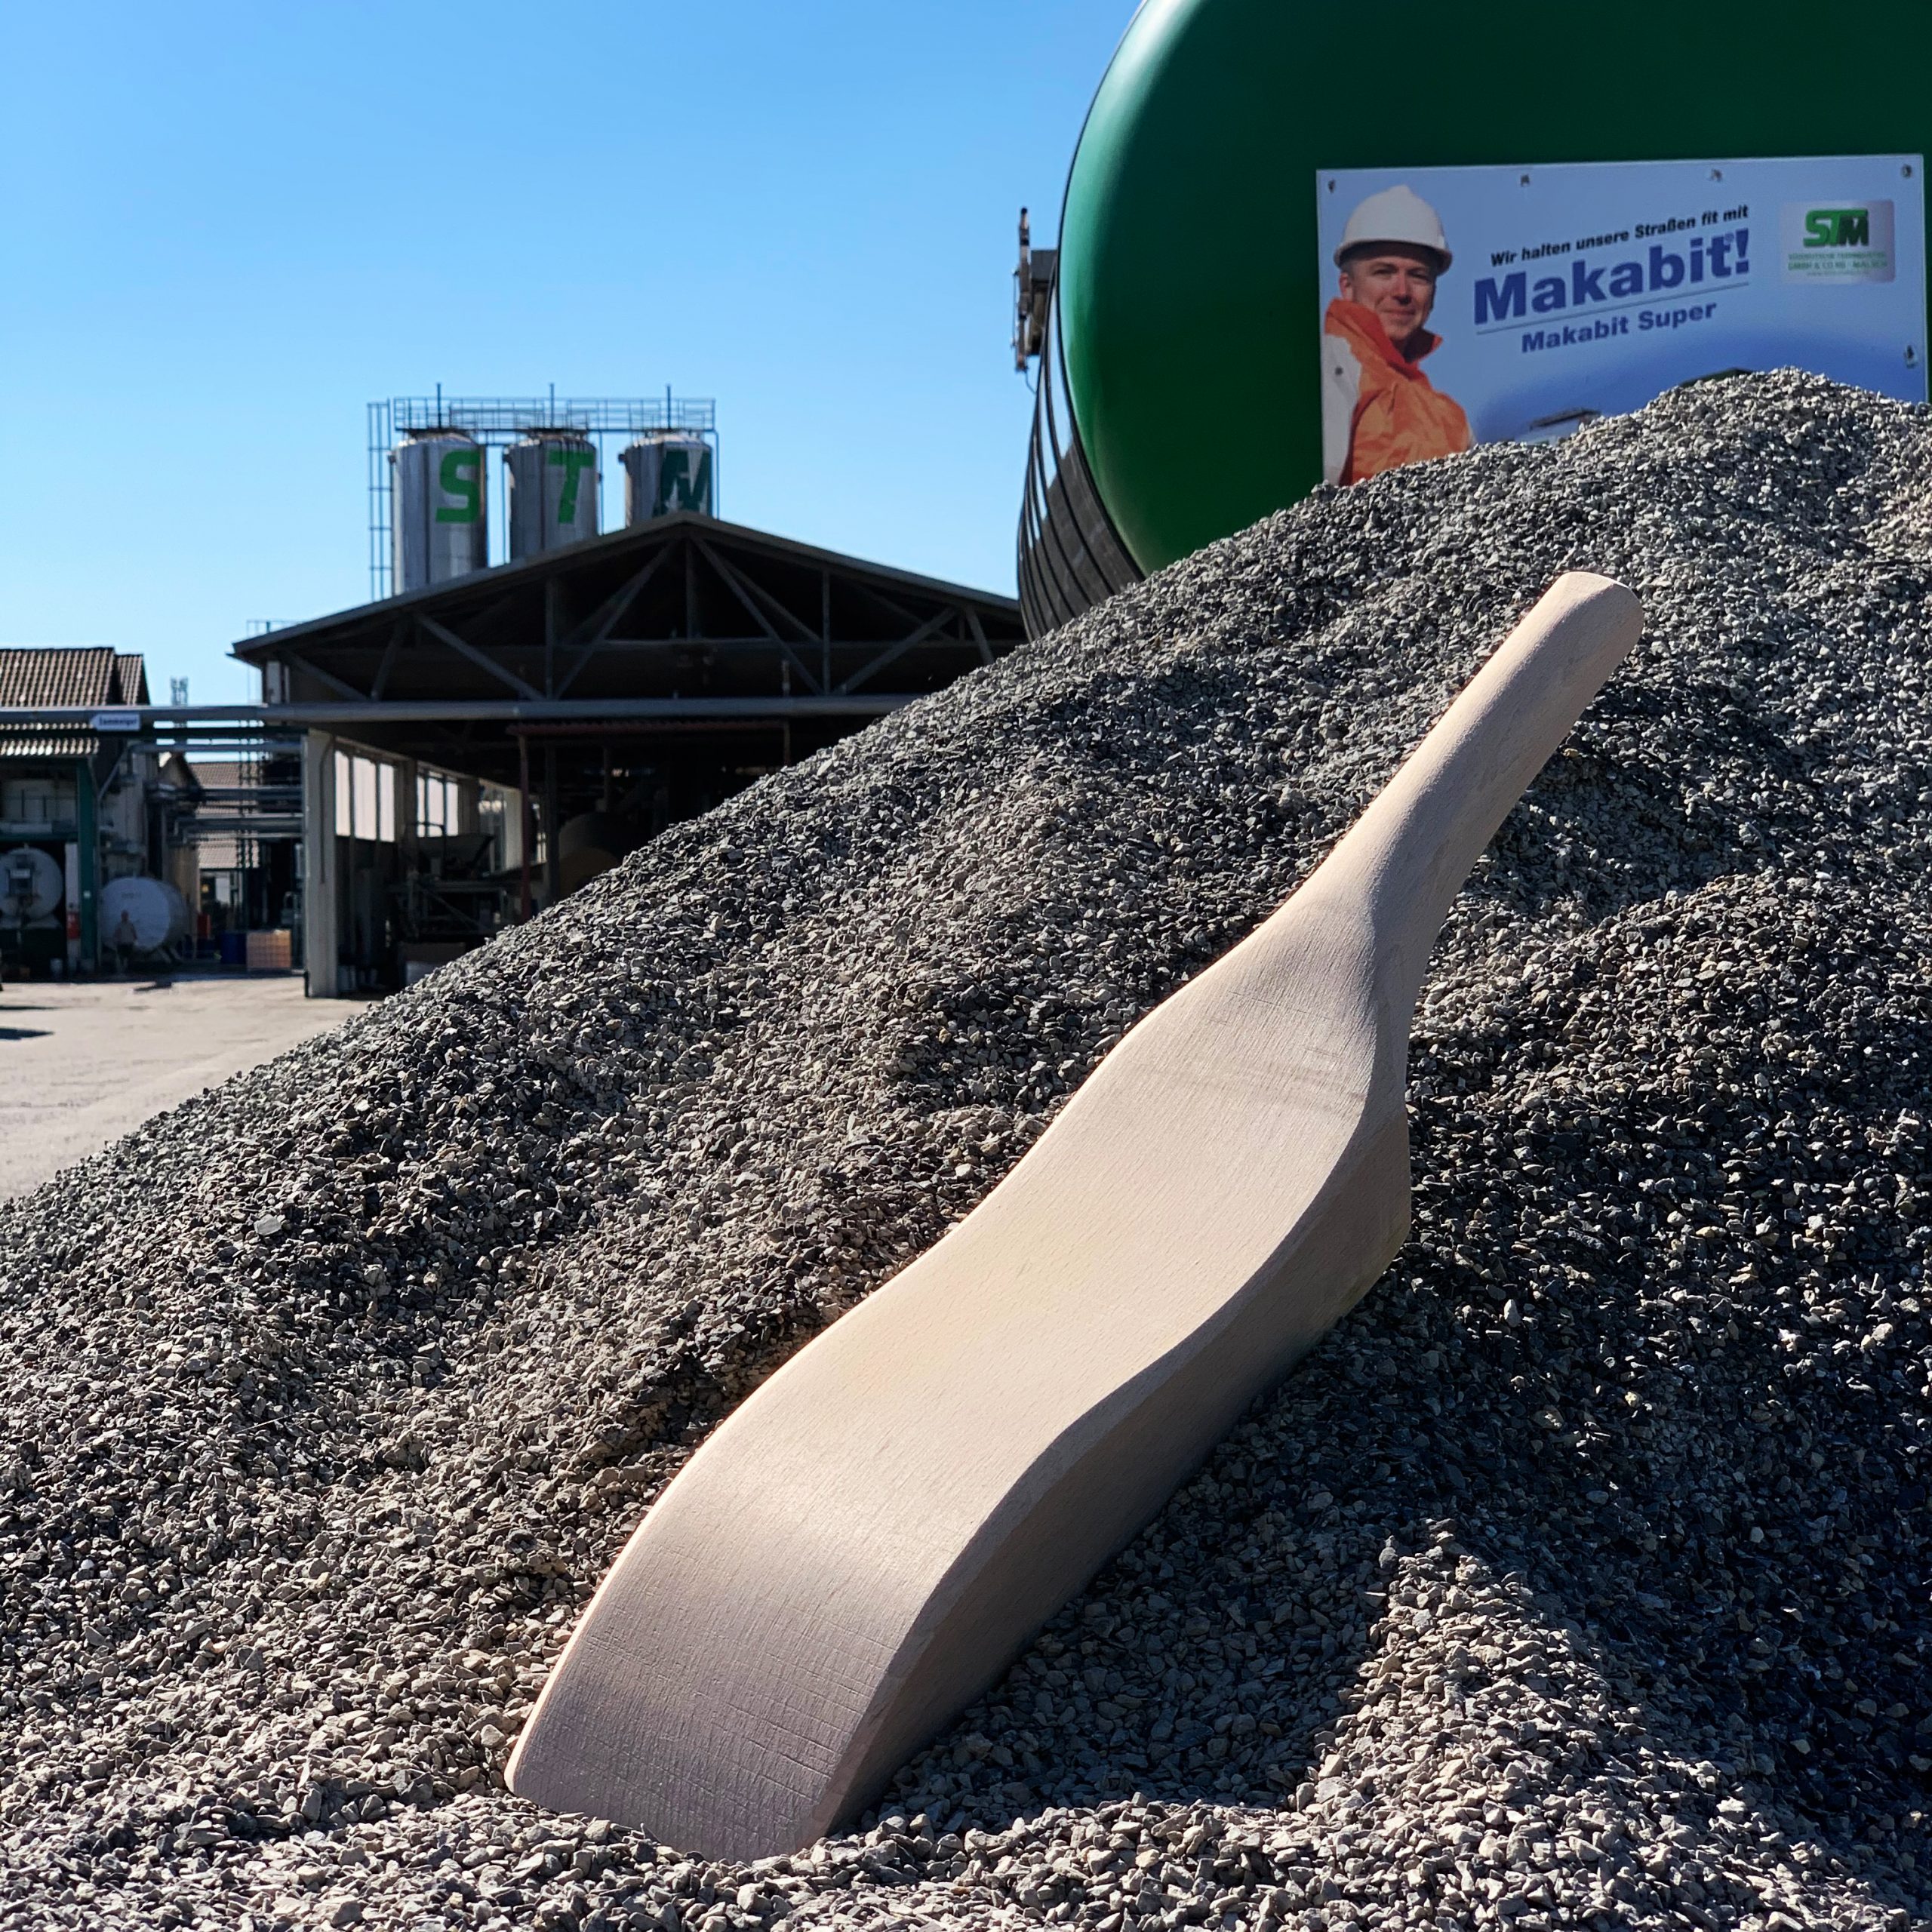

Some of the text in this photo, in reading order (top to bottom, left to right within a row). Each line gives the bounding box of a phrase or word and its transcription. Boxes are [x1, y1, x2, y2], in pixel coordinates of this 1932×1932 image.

[1491, 204, 1749, 267] Wir halten unsere Straßen fit mit
[1803, 208, 1869, 247] STM
[1522, 303, 1717, 353] Makabit Super
